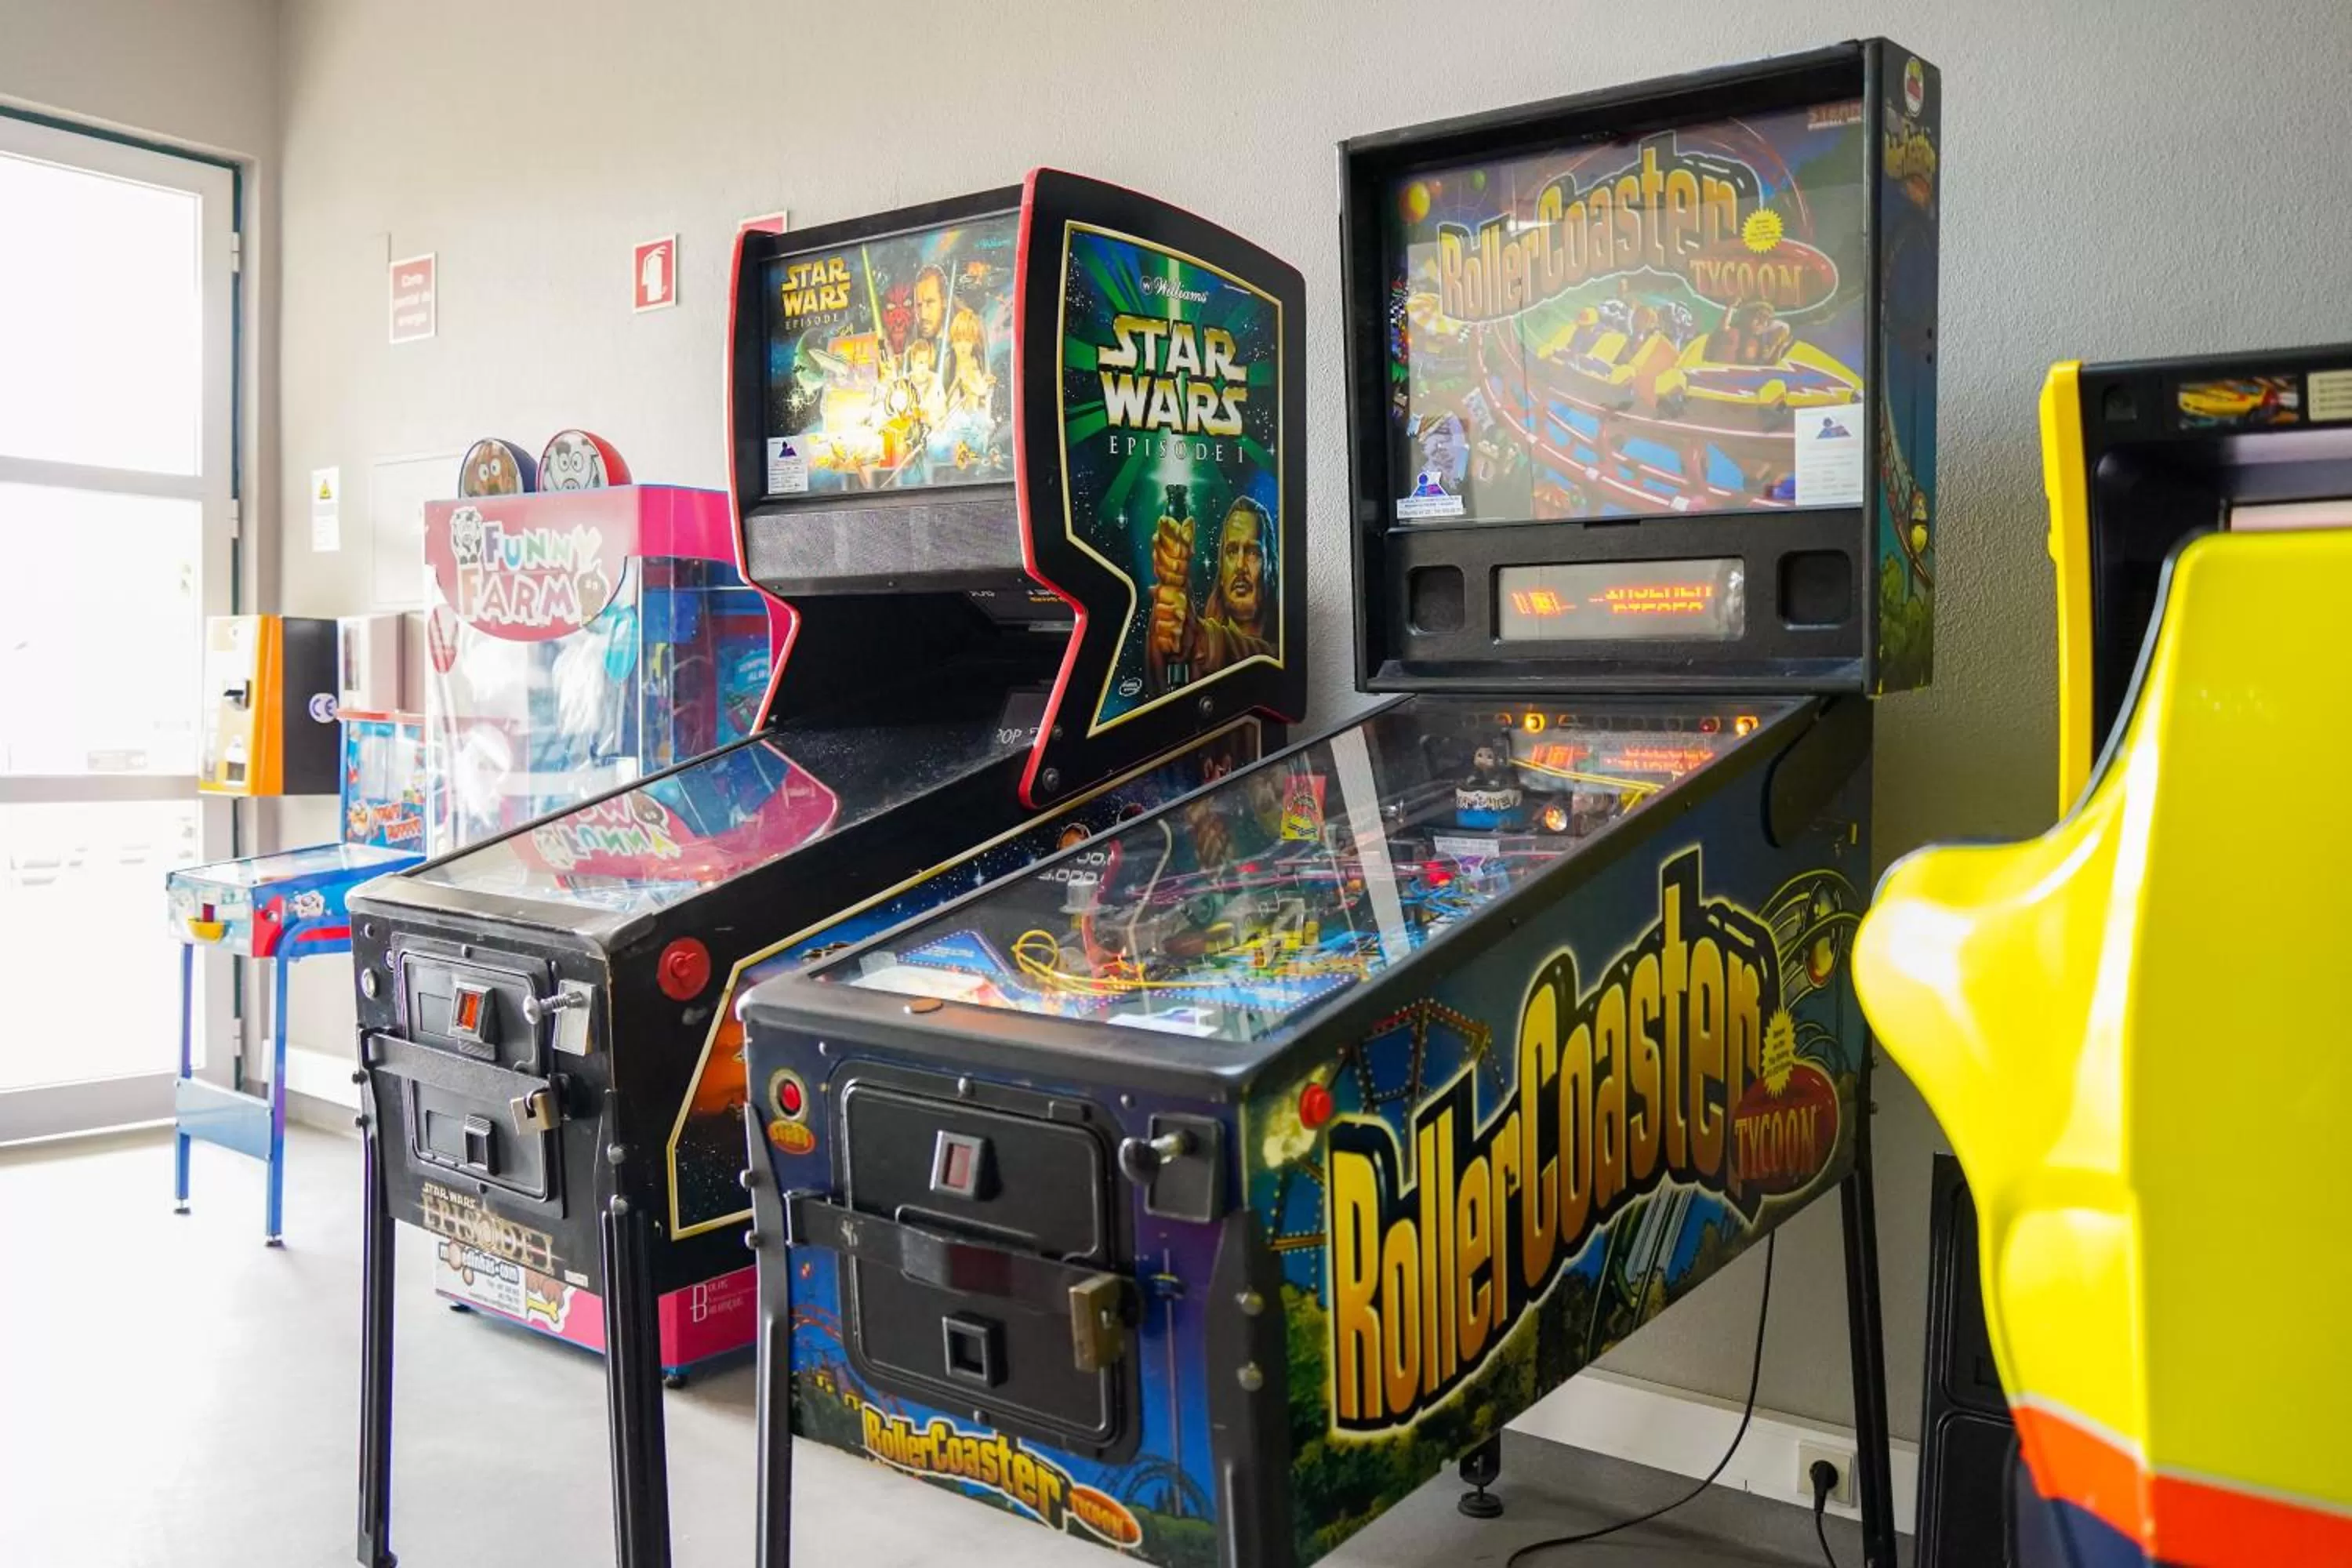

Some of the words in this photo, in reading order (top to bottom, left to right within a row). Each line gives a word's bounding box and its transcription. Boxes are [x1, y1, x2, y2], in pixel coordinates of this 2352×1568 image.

[1441, 147, 1738, 318] RollerCoaster
[782, 256, 851, 291] STAR
[1153, 277, 1207, 304] Williams
[1690, 260, 1802, 307] TYCOON
[782, 281, 851, 318] WARS
[786, 313, 839, 330] EPISODE
[1098, 314, 1247, 381] STAR
[1099, 370, 1247, 436] WARS
[1109, 435, 1224, 463] EPISODE
[481, 521, 602, 572] FUNNY
[459, 564, 579, 627] FARM
[311, 697, 335, 717] CE
[1332, 884, 1761, 1420] RollerCoaster
[1734, 1104, 1817, 1180] TYCOON
[422, 1181, 449, 1200] STAR
[450, 1191, 477, 1208] WARS
[422, 1193, 533, 1264] EPISODE
[865, 1408, 1062, 1526] RollerCoaster
